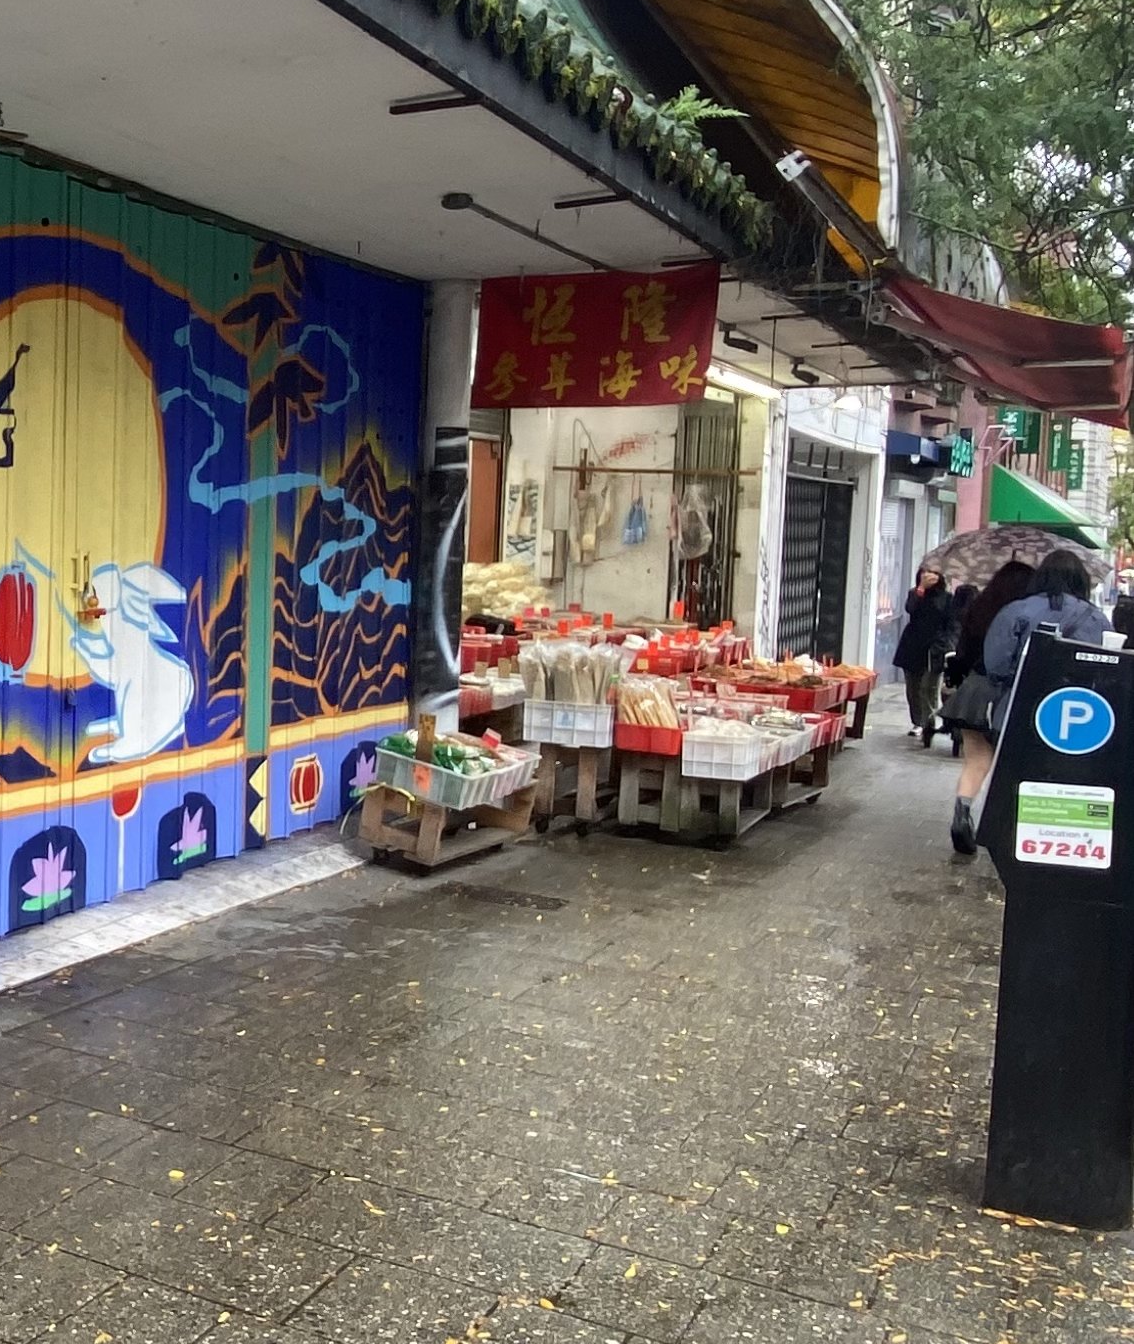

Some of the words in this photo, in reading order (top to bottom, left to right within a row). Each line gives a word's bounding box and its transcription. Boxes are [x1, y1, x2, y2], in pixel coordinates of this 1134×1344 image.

[1059, 700, 1094, 740] P
[1038, 828, 1081, 839] Location
[1021, 839, 1106, 860] 67244
